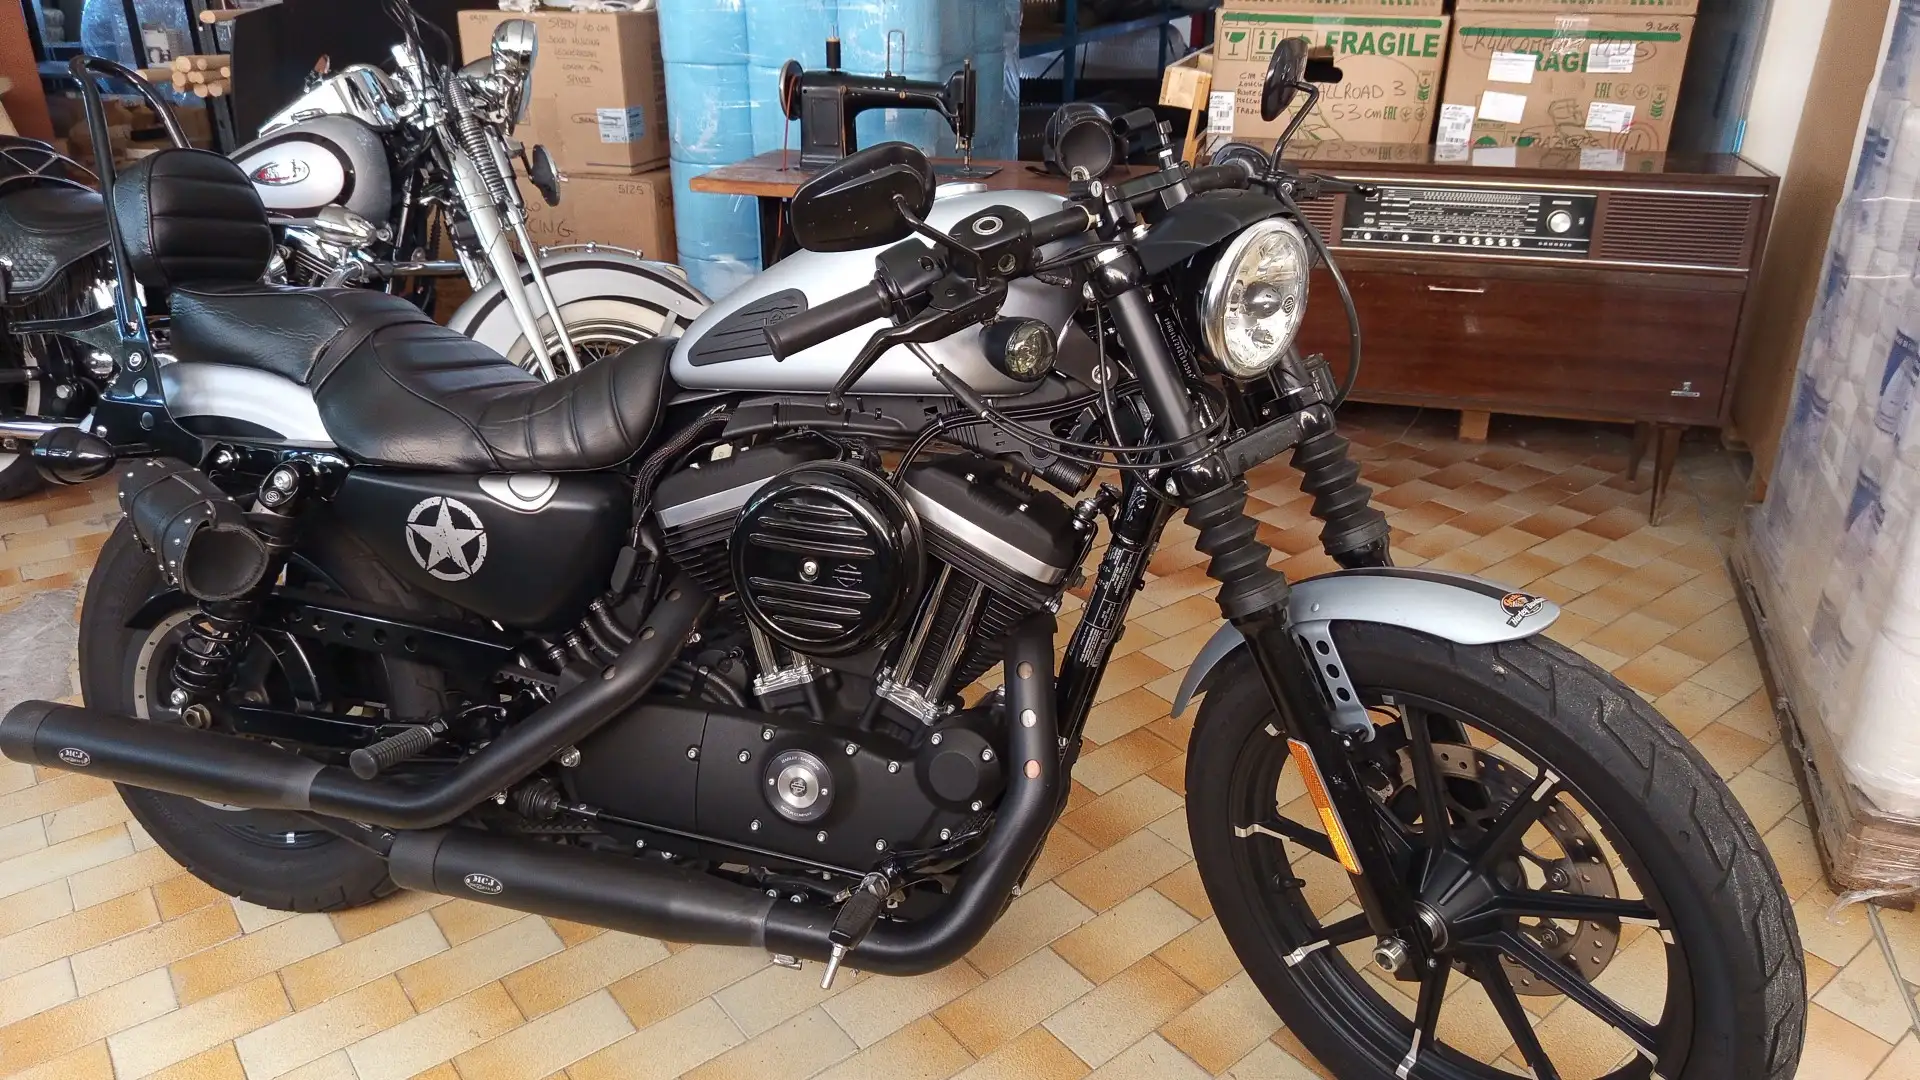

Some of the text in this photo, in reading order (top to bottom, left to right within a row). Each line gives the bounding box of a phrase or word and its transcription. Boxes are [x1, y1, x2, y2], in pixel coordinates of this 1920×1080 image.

[1325, 30, 1441, 58] FRAGILE
[1392, 80, 1408, 97] 3
[1331, 104, 1362, 122] 53
[65, 749, 84, 759] MCJ
[473, 875, 495, 887] MCJ
